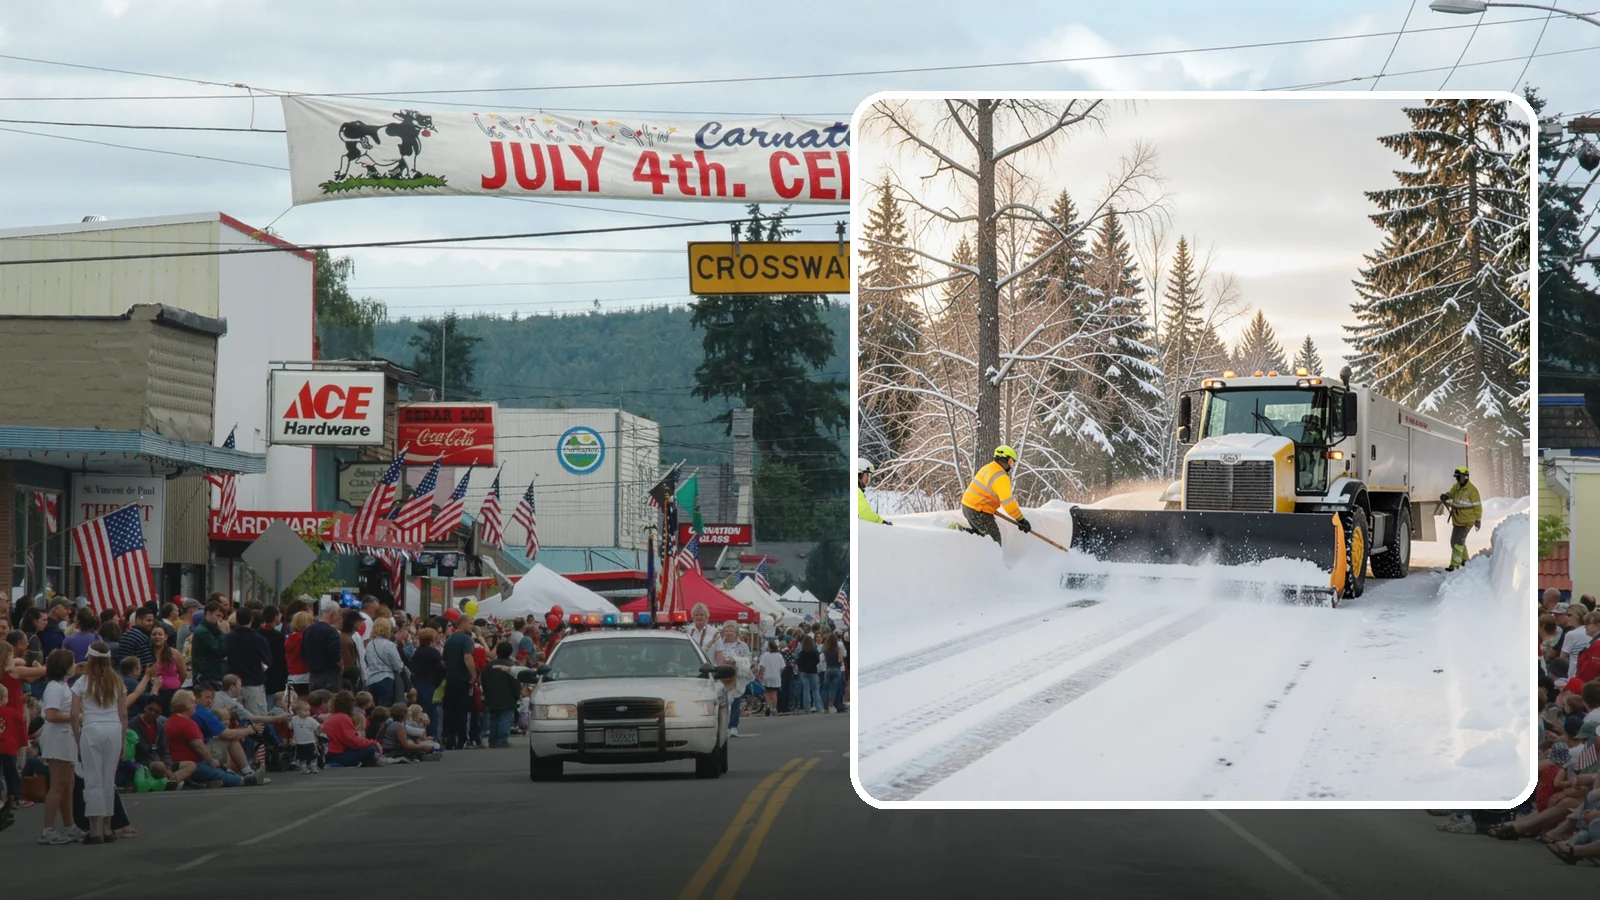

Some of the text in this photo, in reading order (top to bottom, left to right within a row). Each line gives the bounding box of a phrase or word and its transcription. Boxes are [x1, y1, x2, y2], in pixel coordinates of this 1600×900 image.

[481, 141, 605, 192] JULY
[632, 150, 746, 197] 4th.
[697, 254, 850, 280] CROSSWA
[283, 380, 373, 419] ACE
[405, 409, 452, 422] CEDAR
[283, 421, 371, 436] Hardware
[95, 485, 124, 494] Vincent
[126, 486, 136, 494] de
[137, 486, 155, 495] Paul
[688, 526, 741, 535] CRNATION
[699, 535, 730, 543] GLASS
